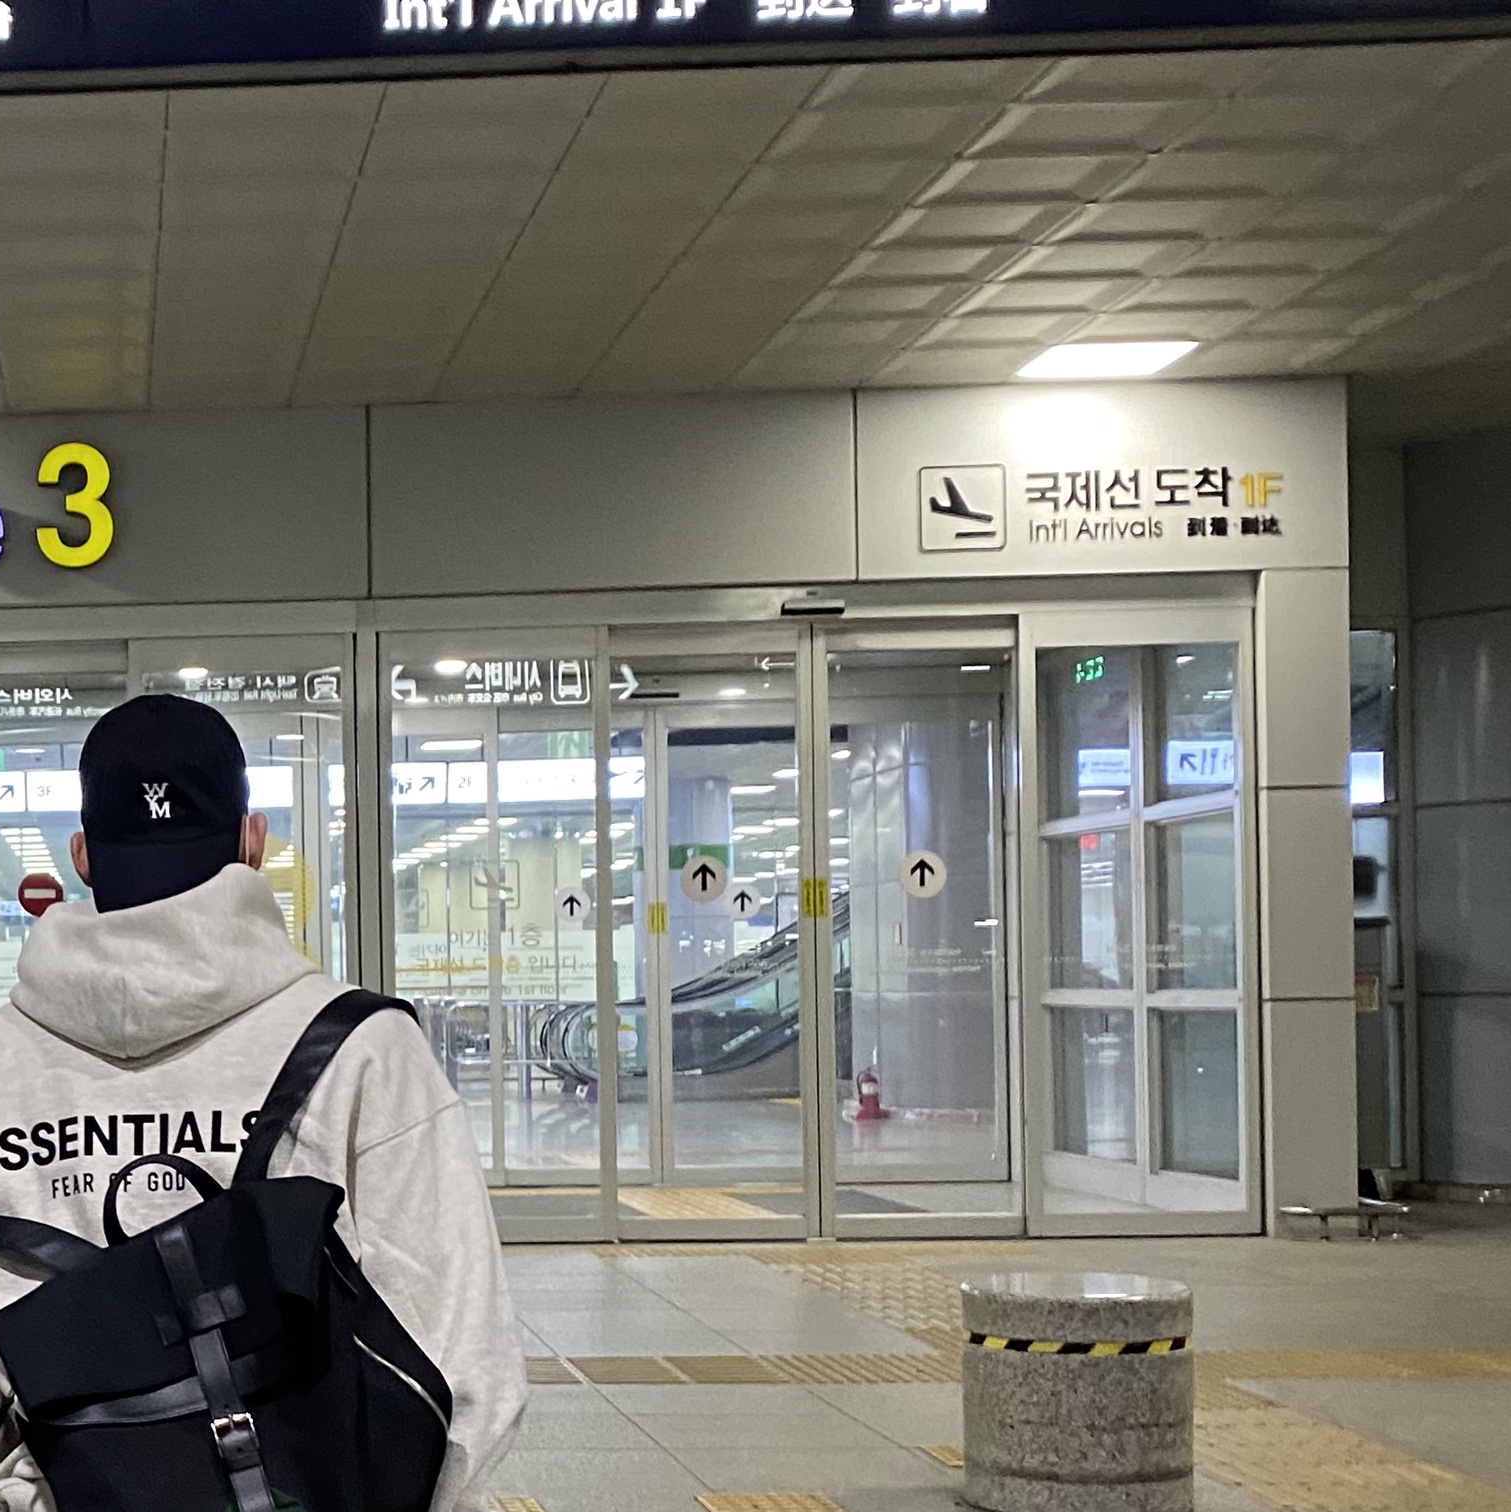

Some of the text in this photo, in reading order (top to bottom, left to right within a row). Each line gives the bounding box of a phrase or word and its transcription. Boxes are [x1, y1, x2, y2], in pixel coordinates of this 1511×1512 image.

[35, 442, 115, 568] 3
[1024, 466, 1282, 513] 국제선 도착 1F
[1028, 519, 1067, 543] Int'l
[1076, 515, 1164, 542] Arrivals
[51, 1172, 94, 1199] FEAR
[147, 1171, 186, 1192] GOD
